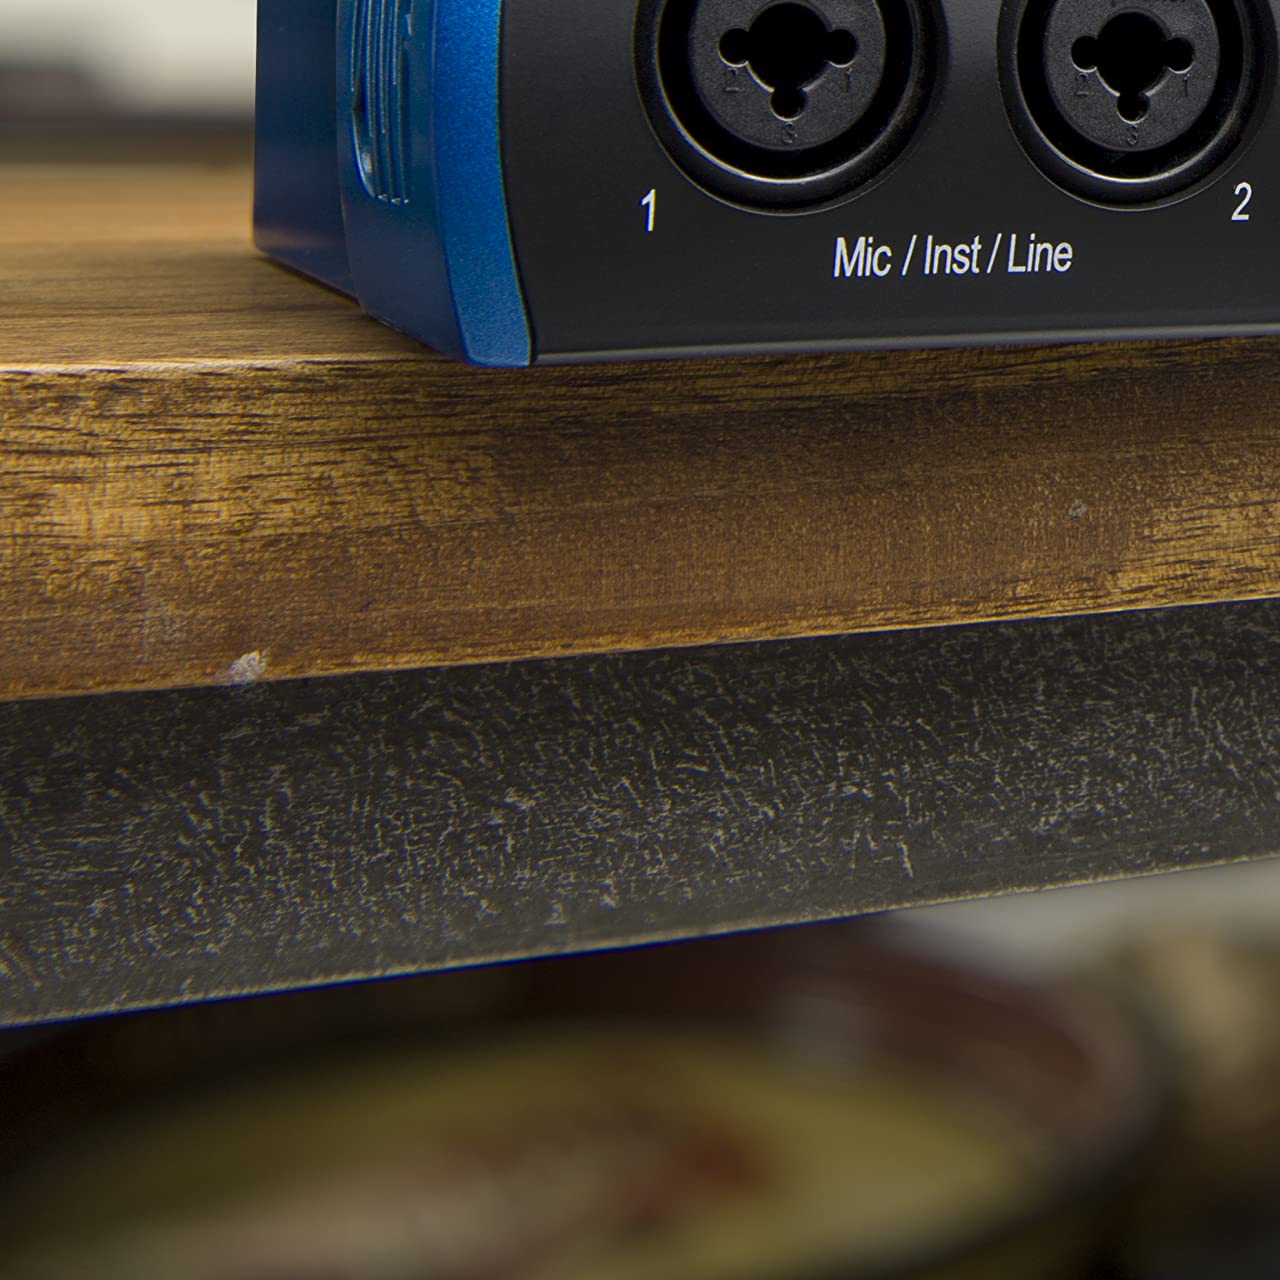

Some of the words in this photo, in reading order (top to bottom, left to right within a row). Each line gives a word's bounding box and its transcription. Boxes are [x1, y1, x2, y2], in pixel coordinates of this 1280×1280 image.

[640, 188, 656, 232] 1
[1231, 181, 1253, 221] 2
[833, 236, 892, 278] Mic
[923, 234, 982, 275] Inst
[1006, 233, 1073, 274] Line
